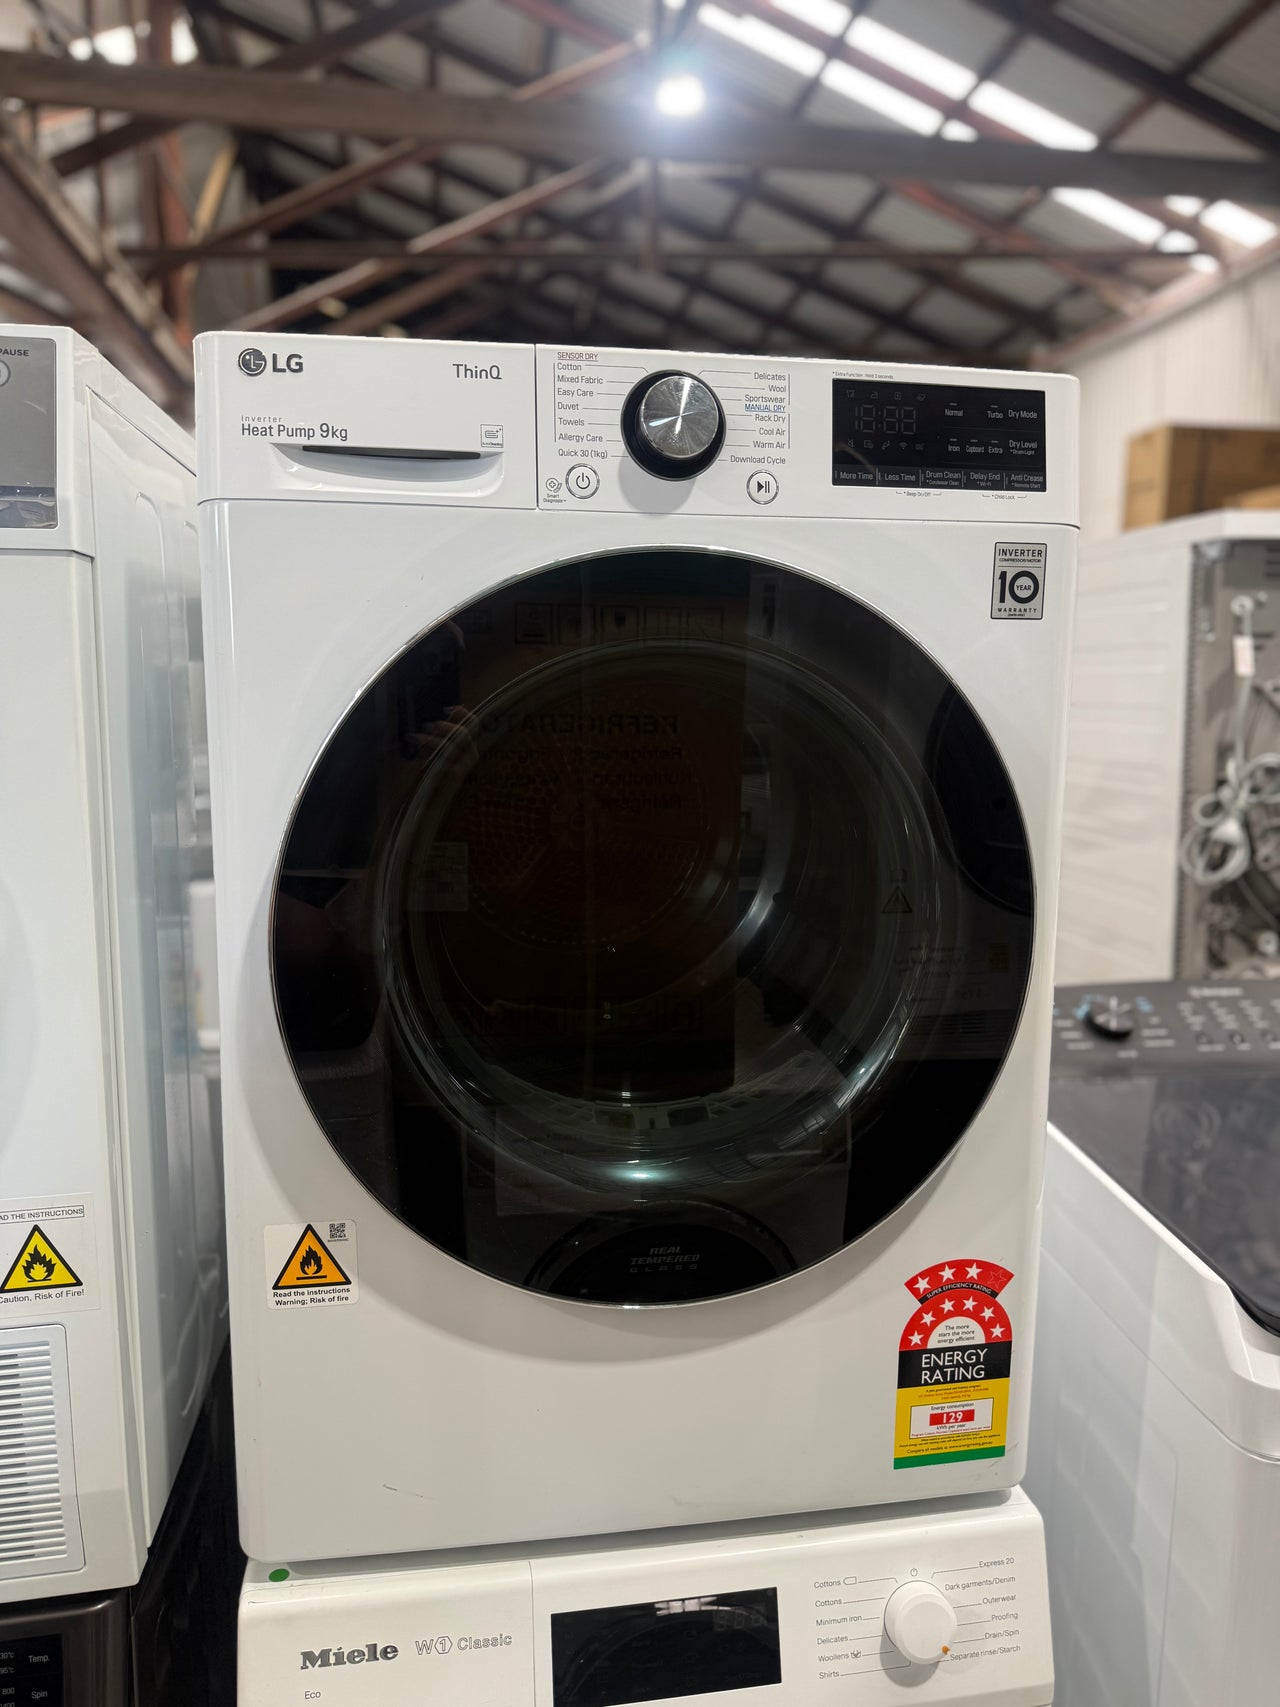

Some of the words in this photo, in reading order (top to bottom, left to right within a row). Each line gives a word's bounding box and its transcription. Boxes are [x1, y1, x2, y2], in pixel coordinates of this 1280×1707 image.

[272, 353, 303, 373] LG
[452, 364, 502, 380] ThinQ
[754, 372, 786, 380] Delicates
[557, 375, 578, 384] Mixed
[580, 376, 603, 384] Fabric
[557, 388, 574, 397] Easy
[745, 395, 785, 404] Sportswear
[241, 415, 282, 423] Inverter
[773, 415, 785, 423] Dry
[1008, 409, 1019, 419] Dry
[558, 418, 584, 426] Towels
[241, 423, 274, 438] Heat
[277, 424, 316, 440] Pump
[319, 423, 348, 441] 9kg
[558, 434, 584, 444] Allergy
[1009, 440, 1020, 449] Dry
[590, 450, 608, 459] (1kg)
[730, 455, 765, 464] Download
[767, 456, 786, 465] Cycle
[999, 549, 1042, 557] INVERTER
[998, 571, 1039, 604] 10
[28, 1208, 83, 1218] INSTRUCTIONS
[649, 1246, 682, 1255] REAL
[630, 1254, 700, 1265] TEMPERED
[629, 1264, 698, 1272] GLASS
[34, 1292, 53, 1300] Risk
[66, 1289, 84, 1297] Fire!
[926, 1288, 942, 1298] SUPER
[973, 1284, 992, 1294] RATING
[922, 1348, 988, 1367] ENERGY
[922, 1365, 985, 1384] RATING
[943, 1412, 963, 1423] 129
[979, 1558, 1004, 1568] Express
[814, 1579, 841, 1589] Cottons
[945, 1582, 960, 1591] Dark
[961, 1576, 1016, 1590] garments/Denim
[815, 1598, 842, 1607] Cottons
[982, 1594, 1016, 1605] Outerwear
[816, 1617, 848, 1626] Minimum
[991, 1612, 1019, 1622] Proofing
[985, 1629, 1019, 1639] Drain/Spin
[457, 1633, 512, 1651] Classic
[817, 1635, 848, 1645] Delicates
[300, 1643, 399, 1670] Miele
[818, 1652, 850, 1662] Woollens
[950, 1650, 979, 1662] Separate
[981, 1644, 1021, 1657] rinse/Starch
[819, 1670, 840, 1679] Shirts
[32, 1691, 48, 1699] Spin
[304, 1690, 321, 1700] Eco
